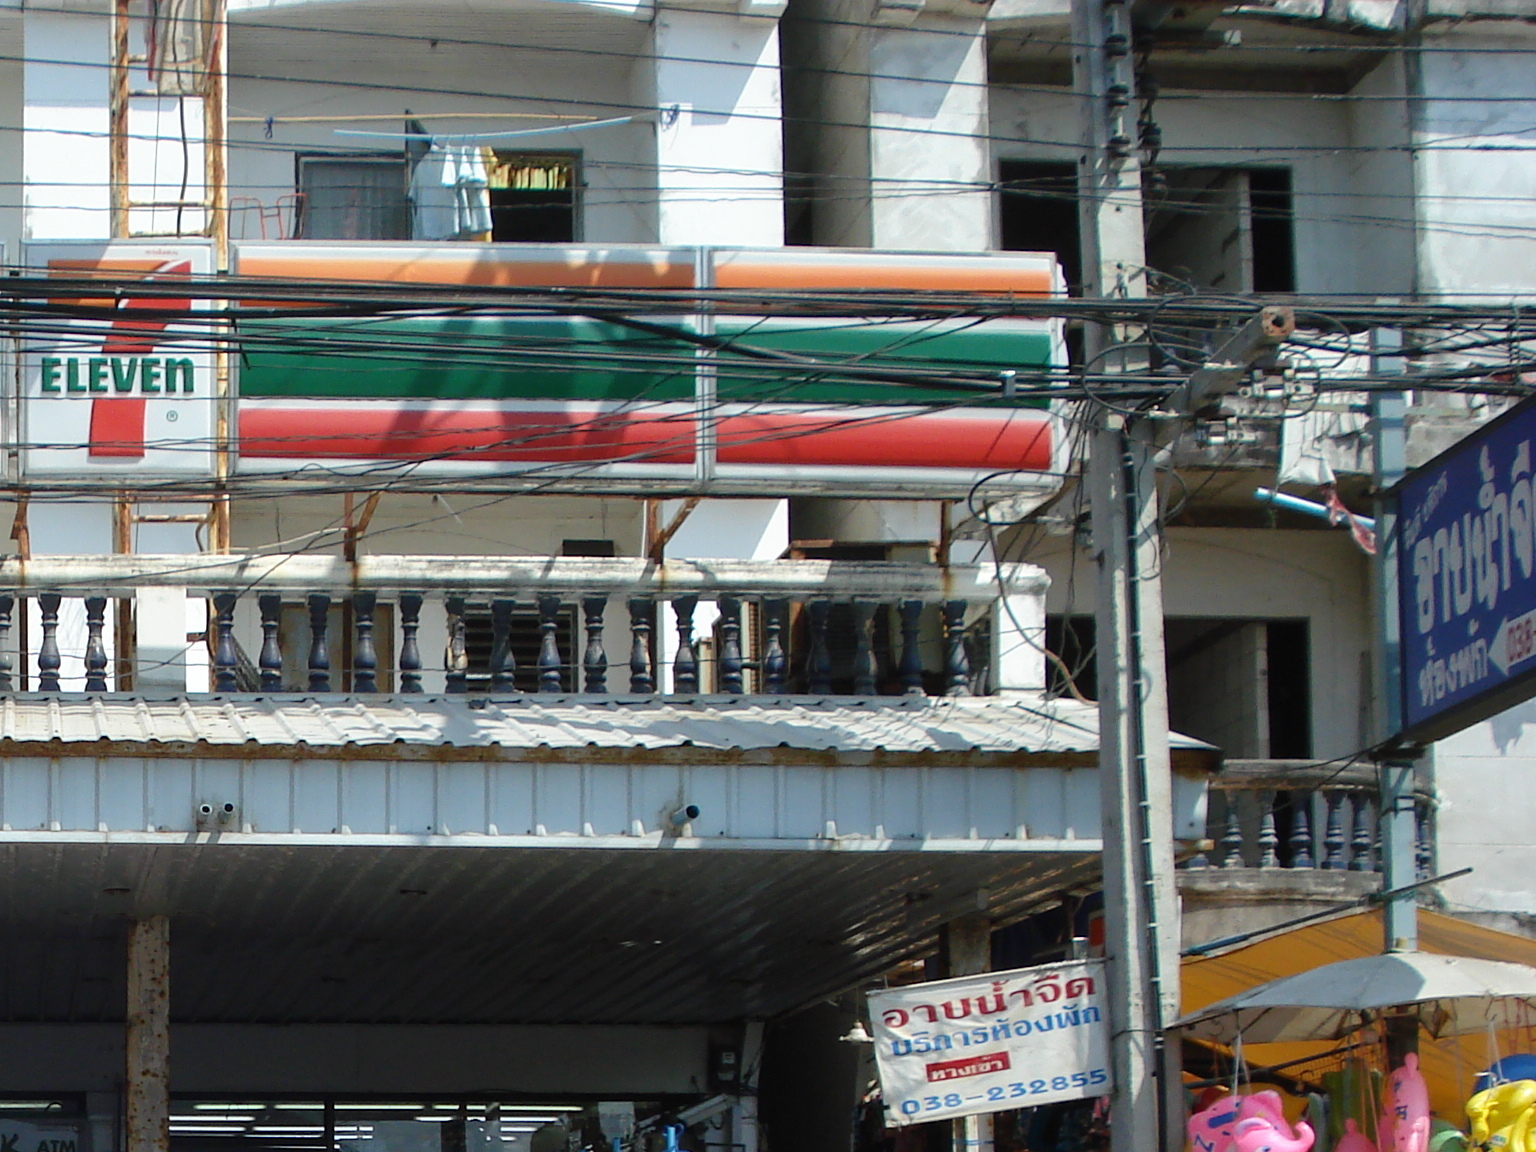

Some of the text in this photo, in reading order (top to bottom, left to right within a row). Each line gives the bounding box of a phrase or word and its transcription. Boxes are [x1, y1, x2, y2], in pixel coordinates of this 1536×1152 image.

[47, 259, 192, 457] 7
[882, 973, 1097, 1029] อาบน้ำจืด
[900, 1068, 1108, 1116] 038-232855
